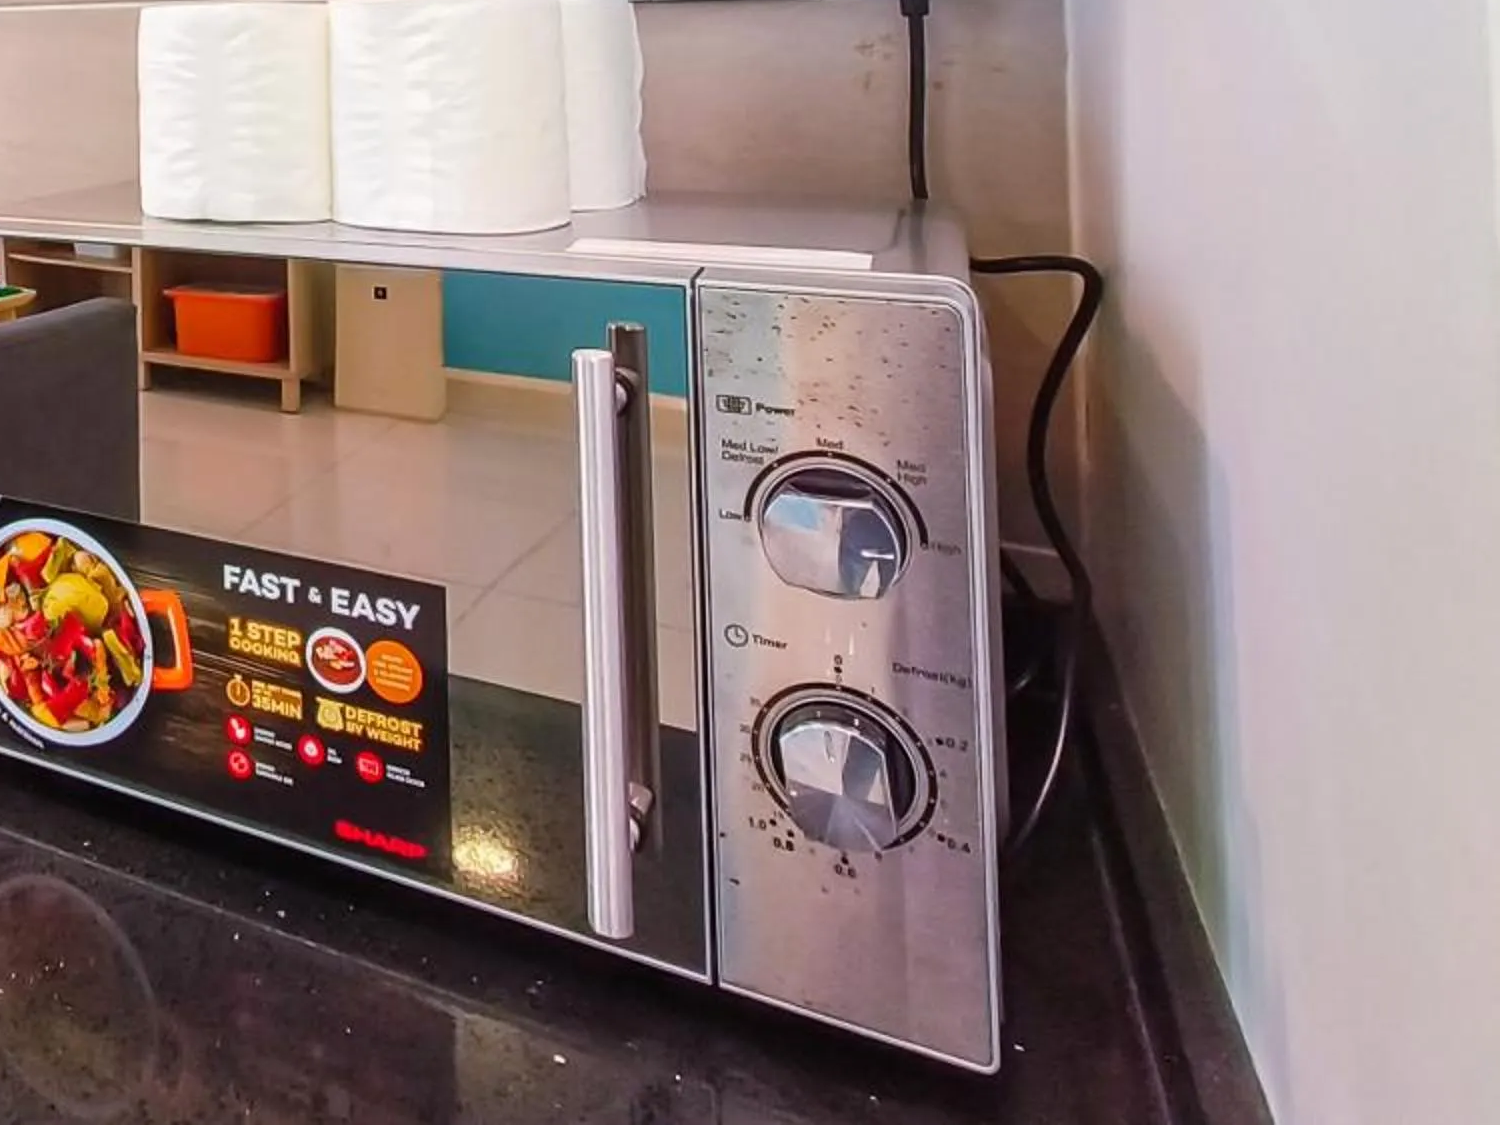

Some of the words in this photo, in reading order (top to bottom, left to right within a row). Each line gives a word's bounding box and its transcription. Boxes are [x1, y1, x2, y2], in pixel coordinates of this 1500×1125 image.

[223, 563, 301, 604] FAST
[307, 586, 322, 604] &
[331, 586, 421, 630] EASY
[228, 617, 243, 637] 1
[246, 620, 301, 649] STEP
[228, 634, 302, 668] COOKING
[345, 704, 423, 738] DEFROST
[345, 721, 364, 737] BY
[366, 724, 422, 752] WEIGHT
